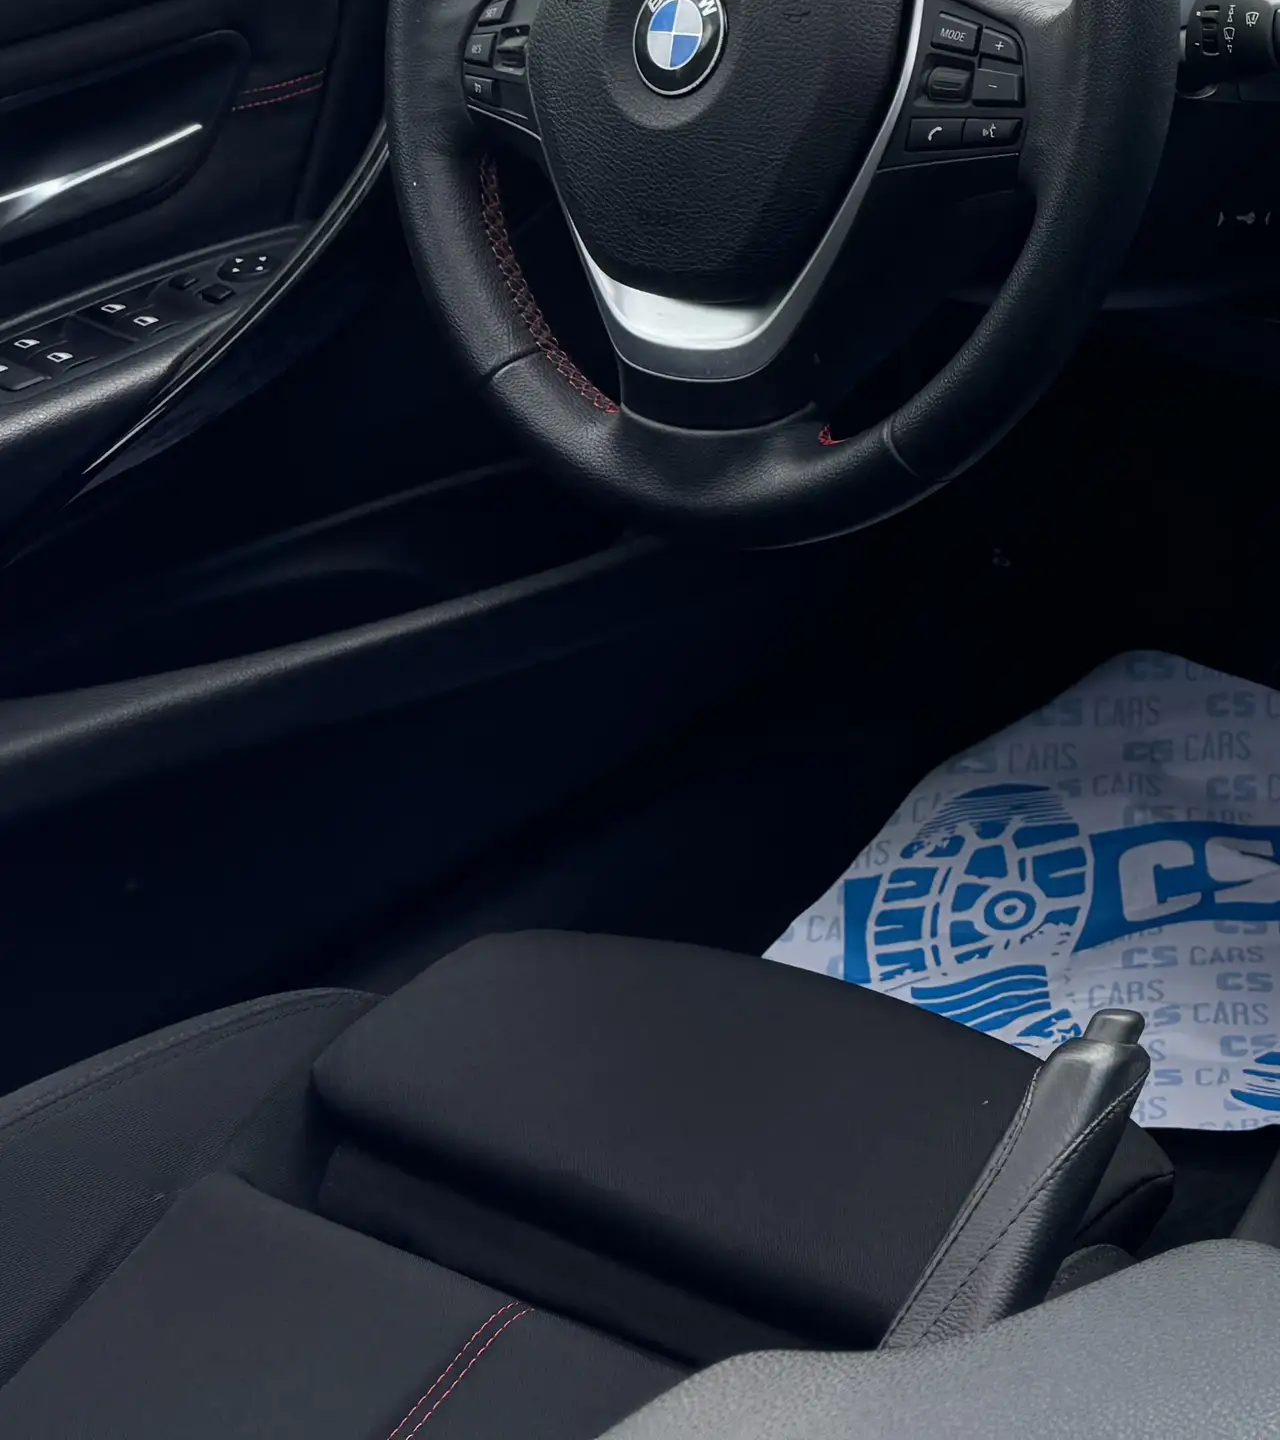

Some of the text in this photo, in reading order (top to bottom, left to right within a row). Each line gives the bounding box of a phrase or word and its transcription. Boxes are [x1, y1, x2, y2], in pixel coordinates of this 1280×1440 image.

[940, 27, 967, 43] MODE
[1093, 694, 1162, 730] CARS
[1205, 690, 1257, 718] CS
[1008, 742, 1078, 775] CARS
[1122, 730, 1253, 763] CS CARS
[1092, 771, 1164, 798] CARS
[1204, 775, 1258, 803] CS
[1121, 946, 1265, 968] CS CARS
[1088, 979, 1166, 1009] CARS
[1215, 971, 1275, 993] CS
[1192, 1000, 1270, 1026] CARS
